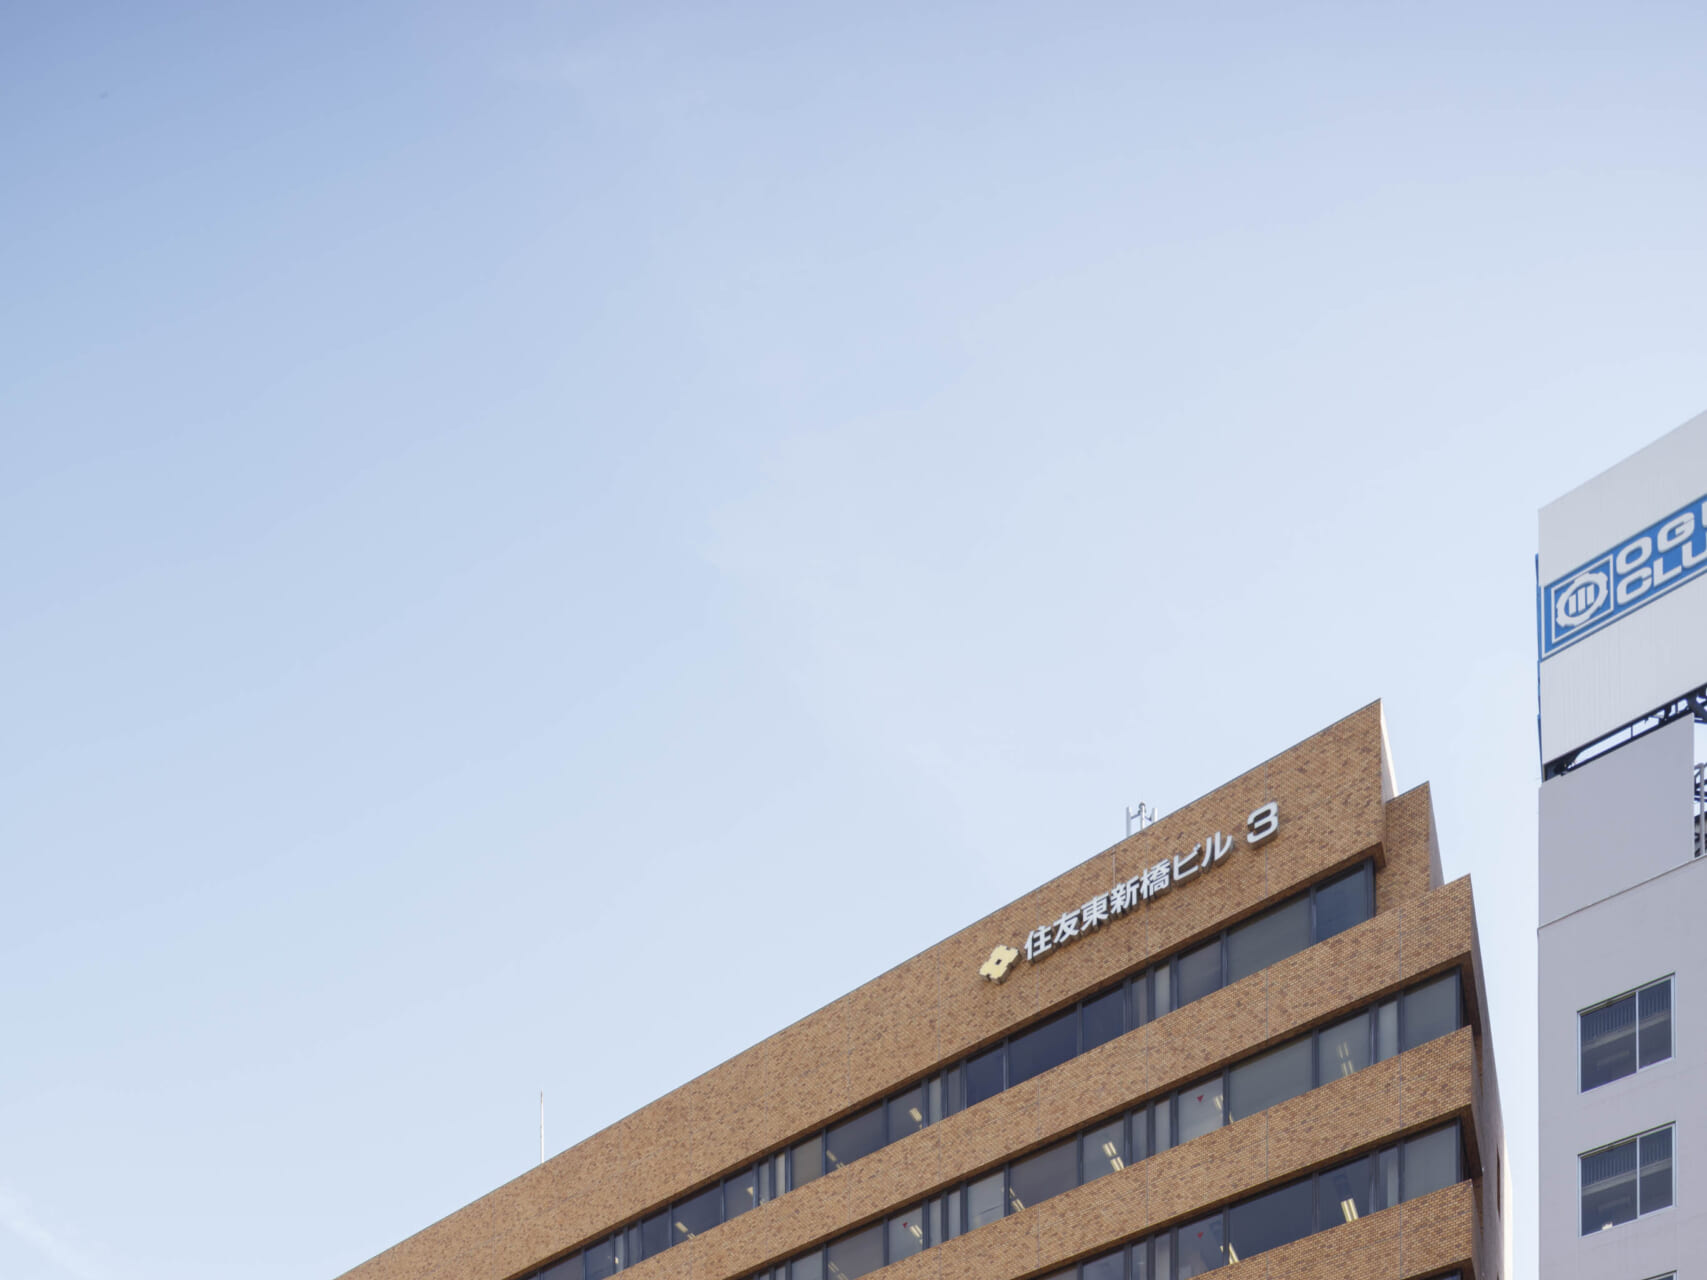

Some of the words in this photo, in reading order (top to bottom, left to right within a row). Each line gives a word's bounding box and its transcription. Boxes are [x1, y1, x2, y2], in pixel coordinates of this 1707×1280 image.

[1024, 831, 1233, 961] 住友東新橋ビル
[1246, 801, 1279, 844] 3
